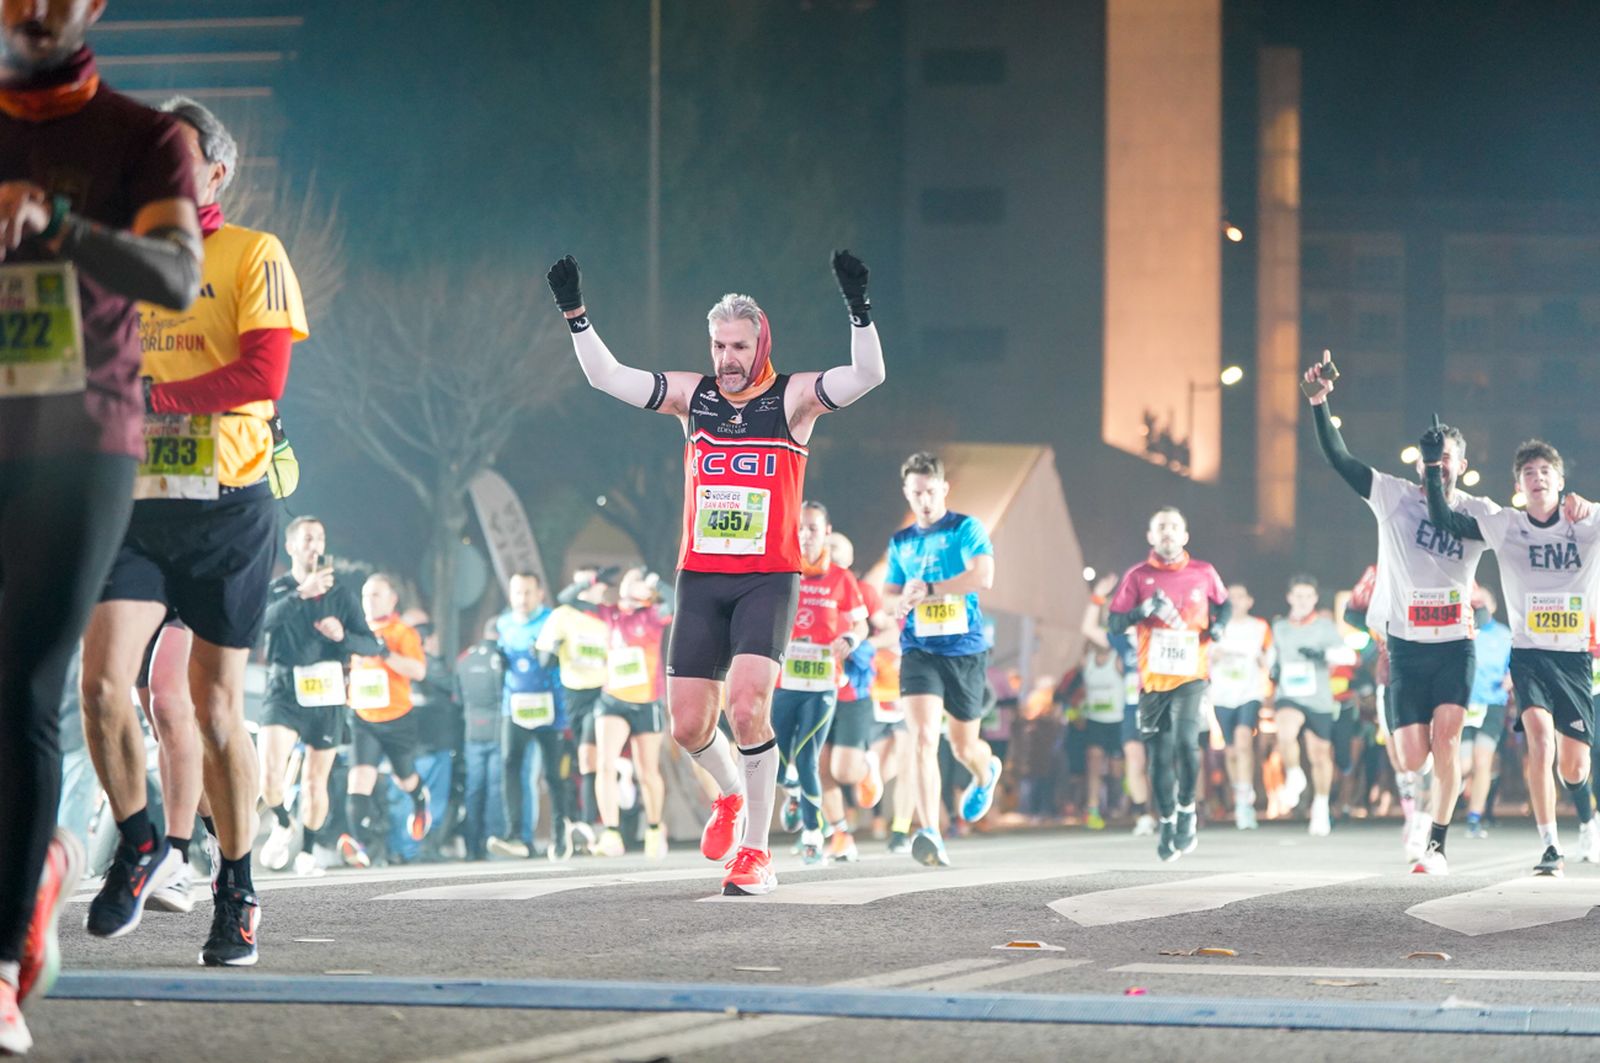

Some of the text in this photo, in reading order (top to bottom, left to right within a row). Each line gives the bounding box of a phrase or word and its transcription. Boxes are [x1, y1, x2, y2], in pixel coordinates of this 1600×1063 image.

[0, 311, 53, 350] 22
[140, 334, 205, 353] ORLDRUN
[703, 453, 776, 476] CGI
[708, 511, 753, 531] 4557
[1416, 519, 1464, 560] ENA
[1529, 542, 1582, 570] ENA
[925, 604, 956, 619] 4736
[1414, 604, 1457, 622] 13494
[1535, 612, 1578, 628] 12916
[794, 661, 825, 676] 6816
